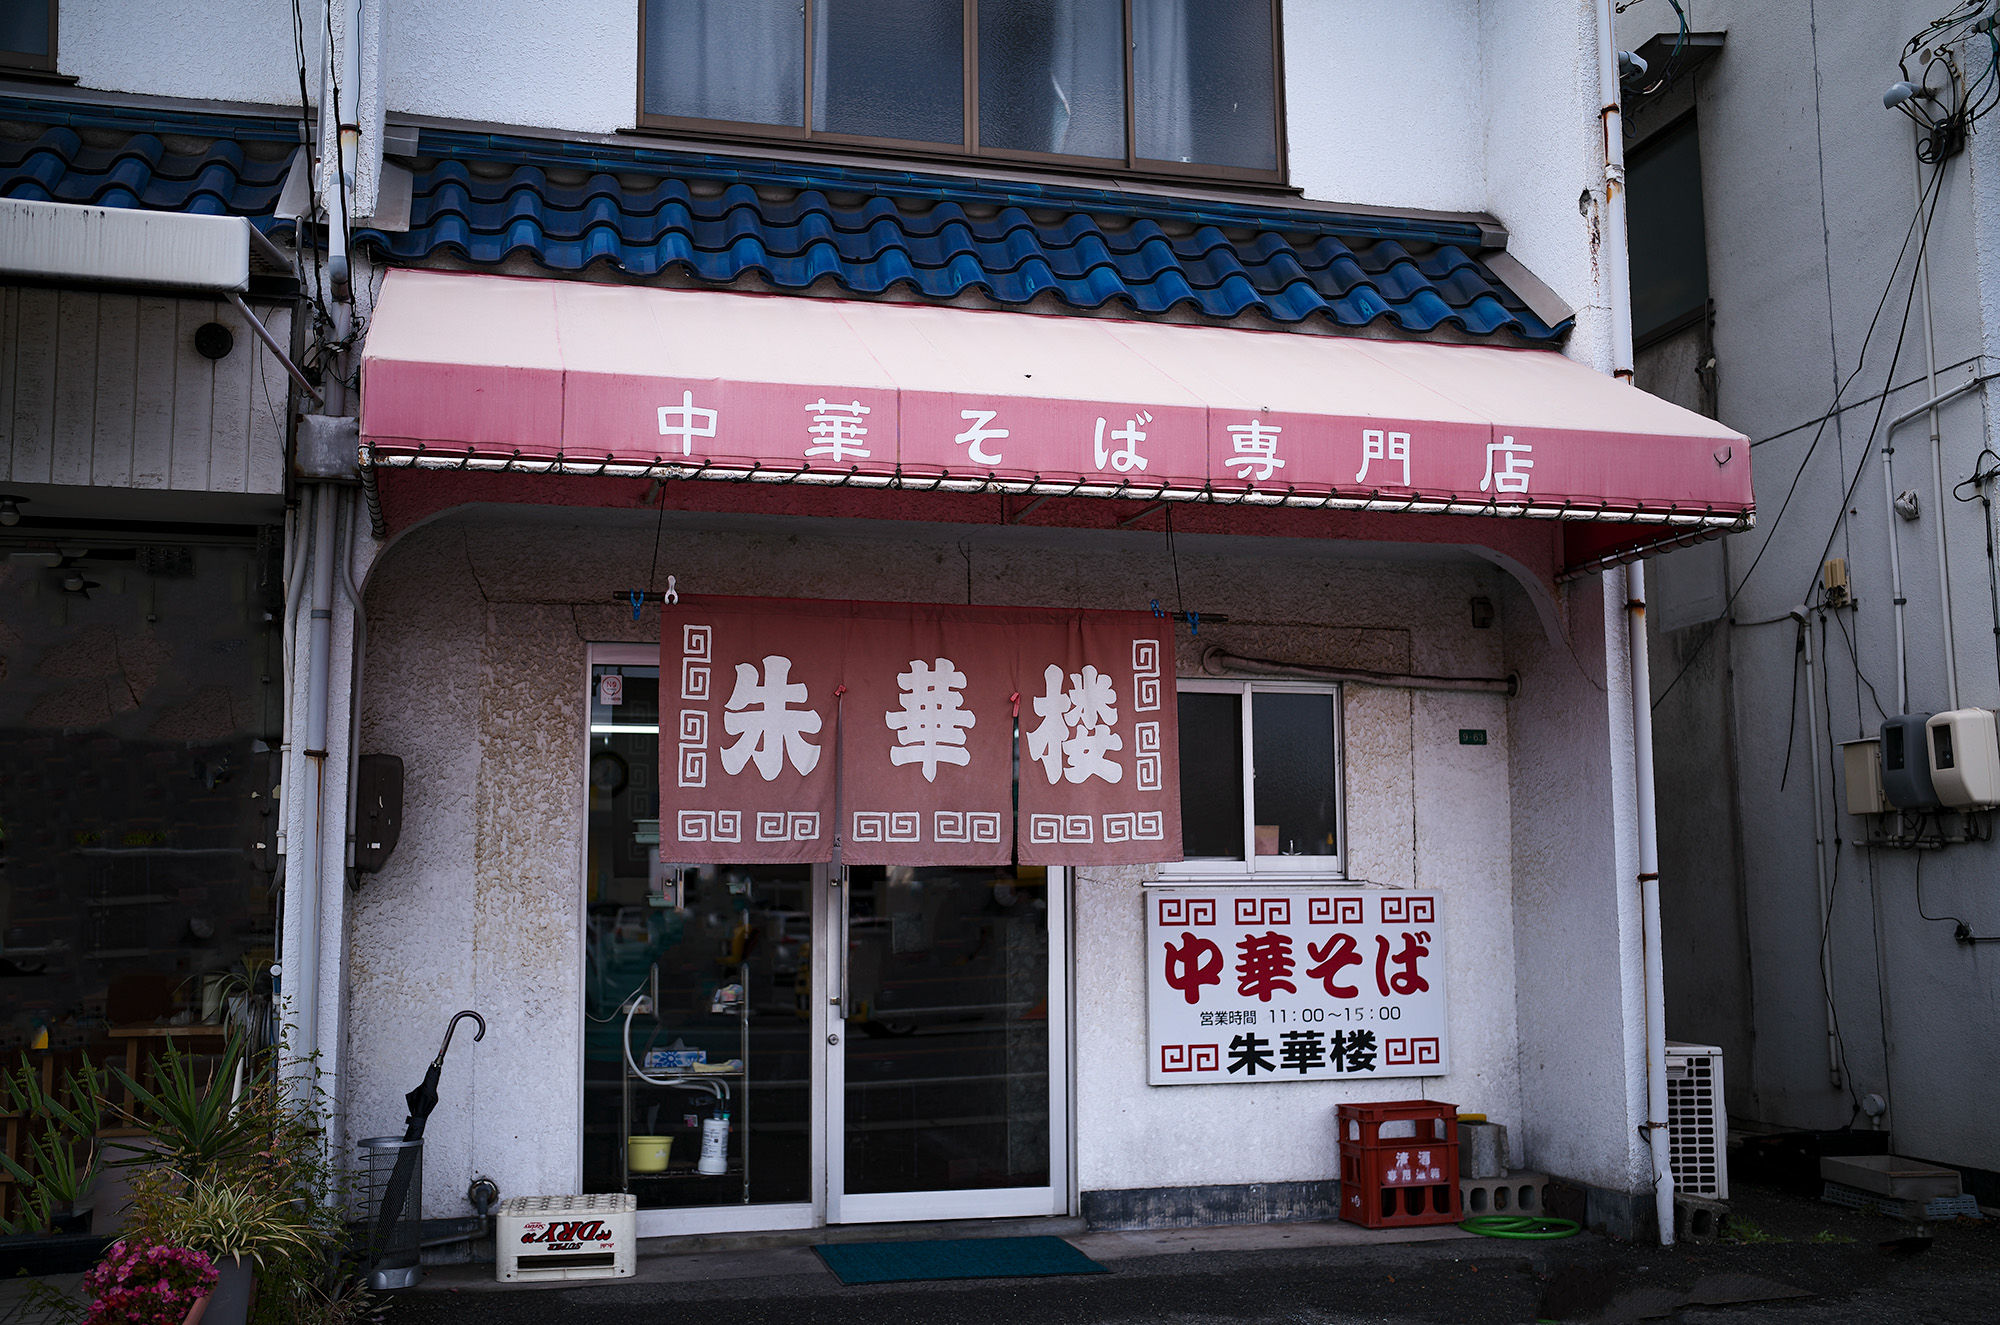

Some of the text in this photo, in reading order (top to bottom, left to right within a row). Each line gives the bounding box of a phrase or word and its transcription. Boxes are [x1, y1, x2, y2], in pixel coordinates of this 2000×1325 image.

[657, 390, 1535, 494] 中華そば専門店
[720, 655, 1123, 785] 朱華楼
[1164, 931, 1432, 1004] 中華そば
[1200, 1010, 1257, 1026] 営業時間
[1226, 1029, 1378, 1076] 朱華楼
[546, 1242, 584, 1250] SUPER
